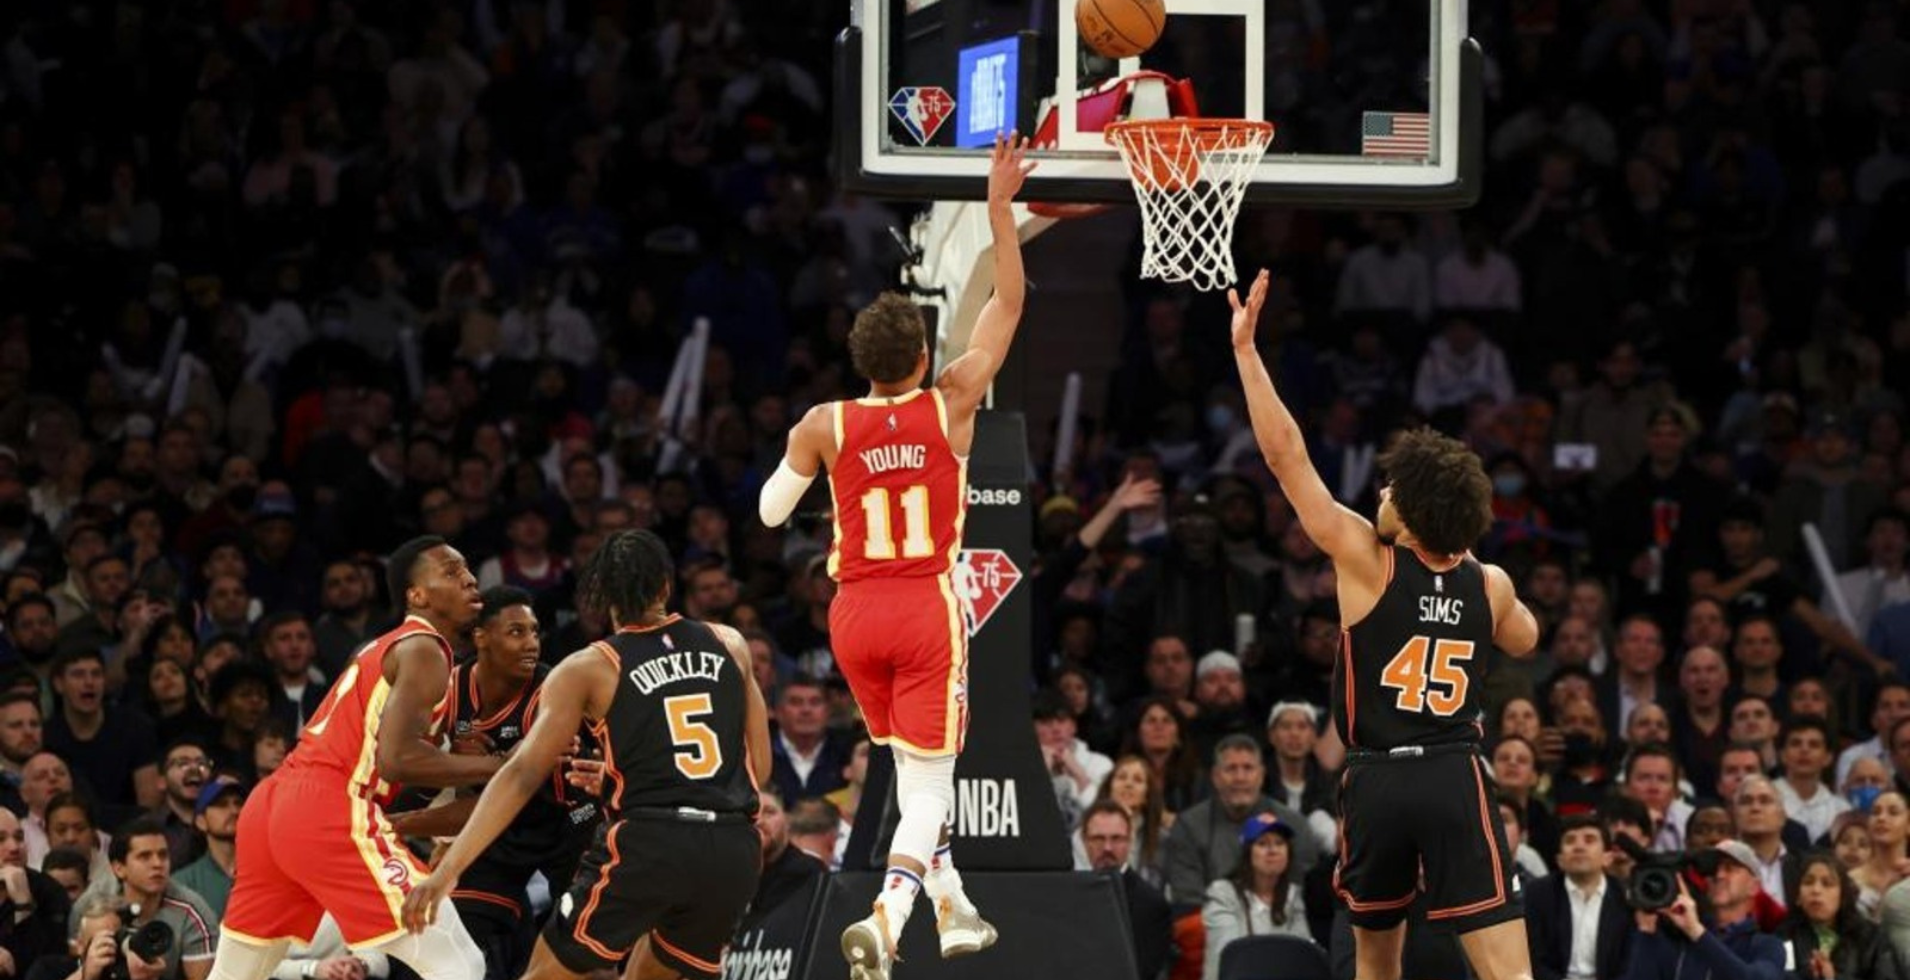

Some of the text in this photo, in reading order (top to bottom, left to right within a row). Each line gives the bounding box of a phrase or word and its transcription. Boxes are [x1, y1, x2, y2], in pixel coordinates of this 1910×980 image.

[860, 445, 925, 474] YOUNG
[861, 484, 935, 560] 11
[981, 561, 1000, 588] 75
[1419, 595, 1463, 625] SIMS
[629, 651, 725, 695] QUICKLEY
[1380, 634, 1475, 716] 45
[664, 693, 723, 780] 5
[958, 778, 1020, 837] NBA
